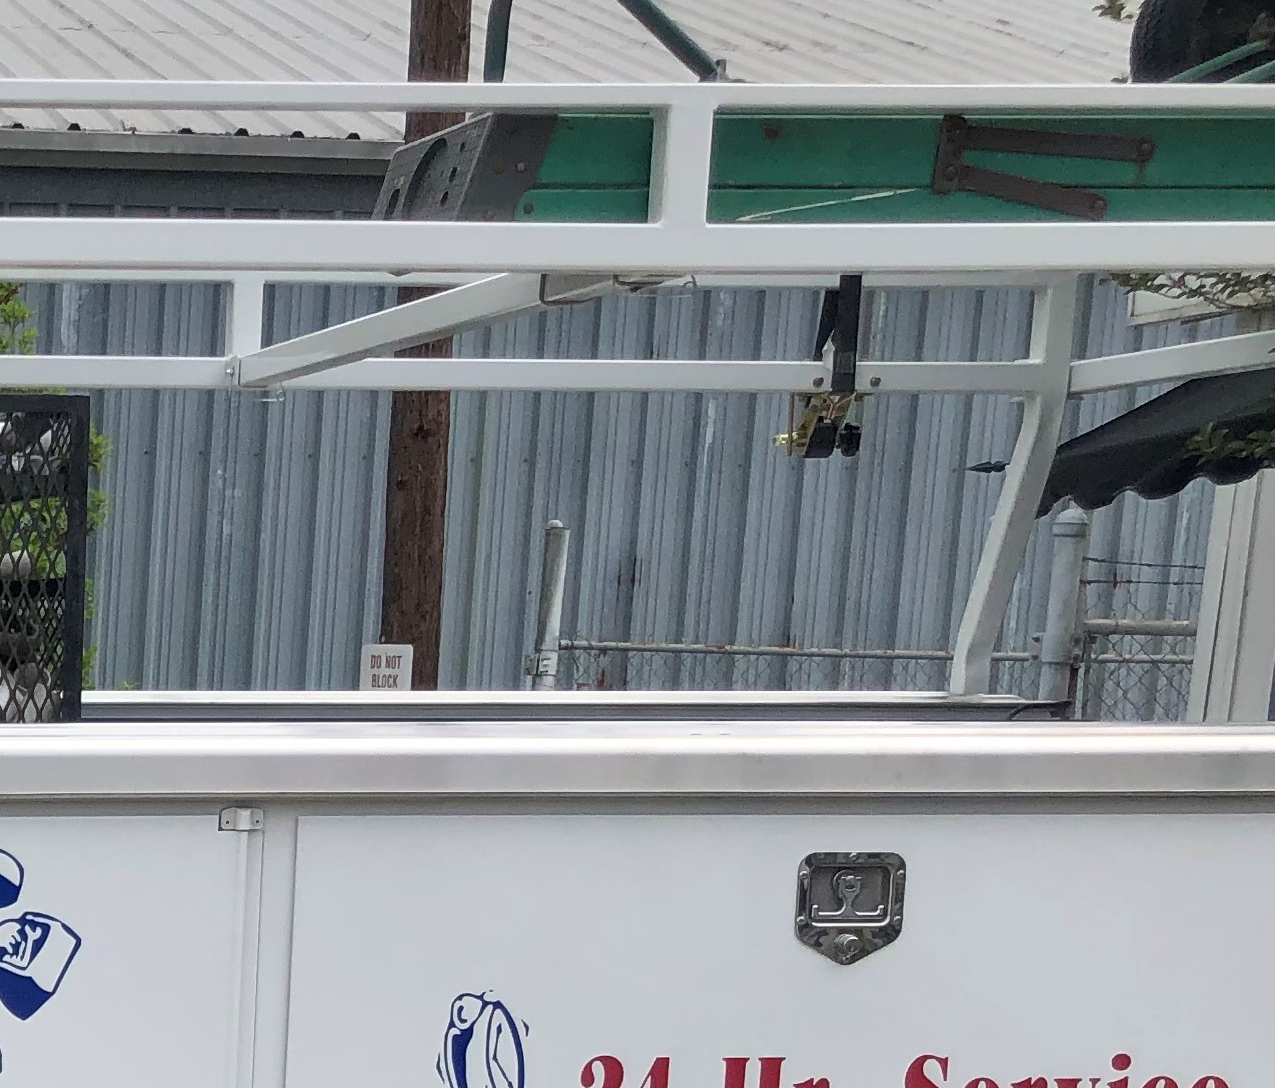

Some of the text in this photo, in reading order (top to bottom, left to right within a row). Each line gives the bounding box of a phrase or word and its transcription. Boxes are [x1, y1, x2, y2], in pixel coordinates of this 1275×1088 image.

[370, 654, 402, 670] DO NOT
[371, 673, 398, 689] BLOCK
